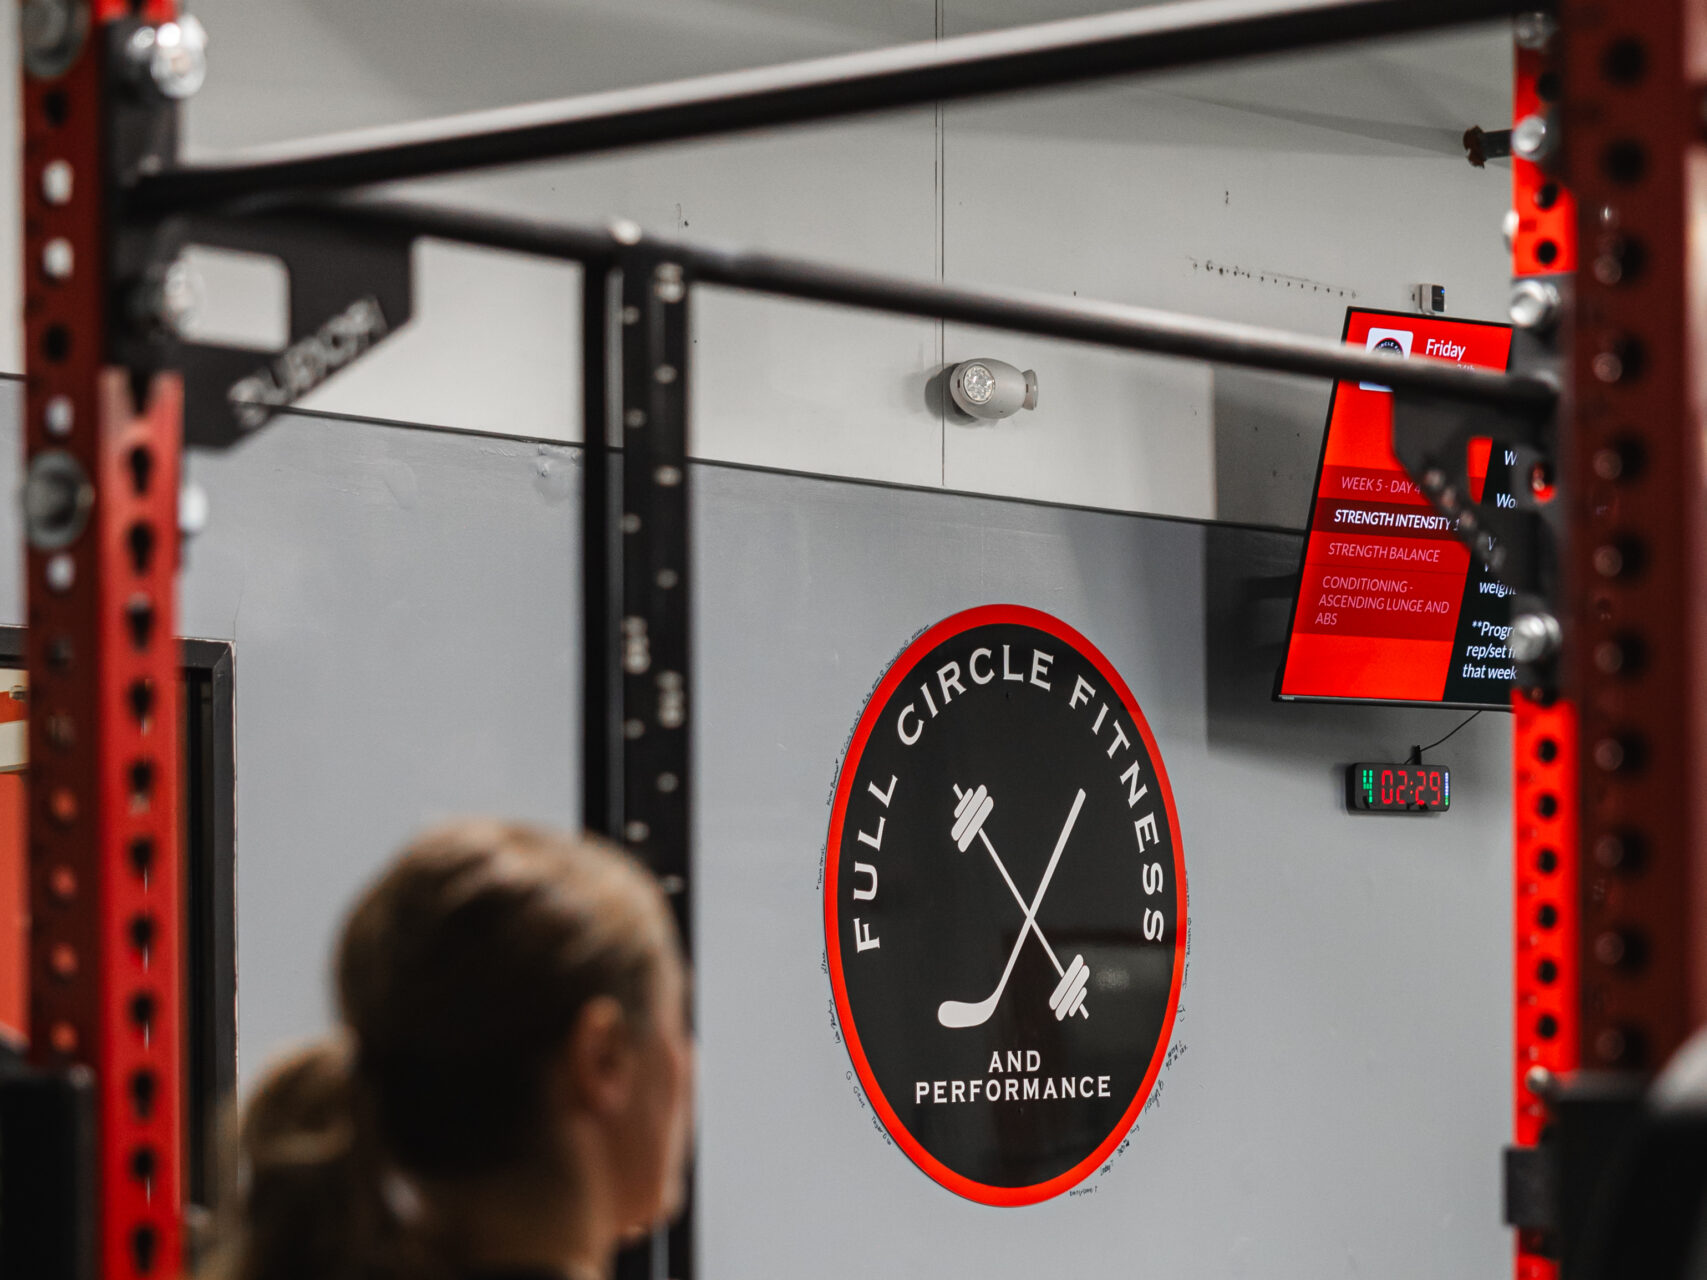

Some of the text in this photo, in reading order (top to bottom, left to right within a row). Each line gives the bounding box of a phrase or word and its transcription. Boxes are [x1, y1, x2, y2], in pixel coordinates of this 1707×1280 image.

[1425, 338, 1466, 361] Friday
[1341, 476, 1374, 491] WEEK
[1376, 478, 1383, 491] 5
[1390, 480, 1413, 494] DAY
[1334, 509, 1394, 527] STRENGTH
[1395, 513, 1451, 531] INTENSITY
[1328, 542, 1440, 562] STRENGTH BALANCE
[1322, 576, 1408, 593] CONDITIONING
[1318, 594, 1449, 614] ASCENDING LUNGE AND
[1315, 612, 1337, 625] ABS
[1466, 643, 1506, 659] rep/set
[1462, 663, 1487, 679] that
[1362, 769, 1441, 805] 4 02:29
[853, 644, 1165, 953] FULL CIRCLE FITNESS
[988, 1050, 1041, 1073] AND
[915, 1075, 1111, 1105] PERFORMANCE
